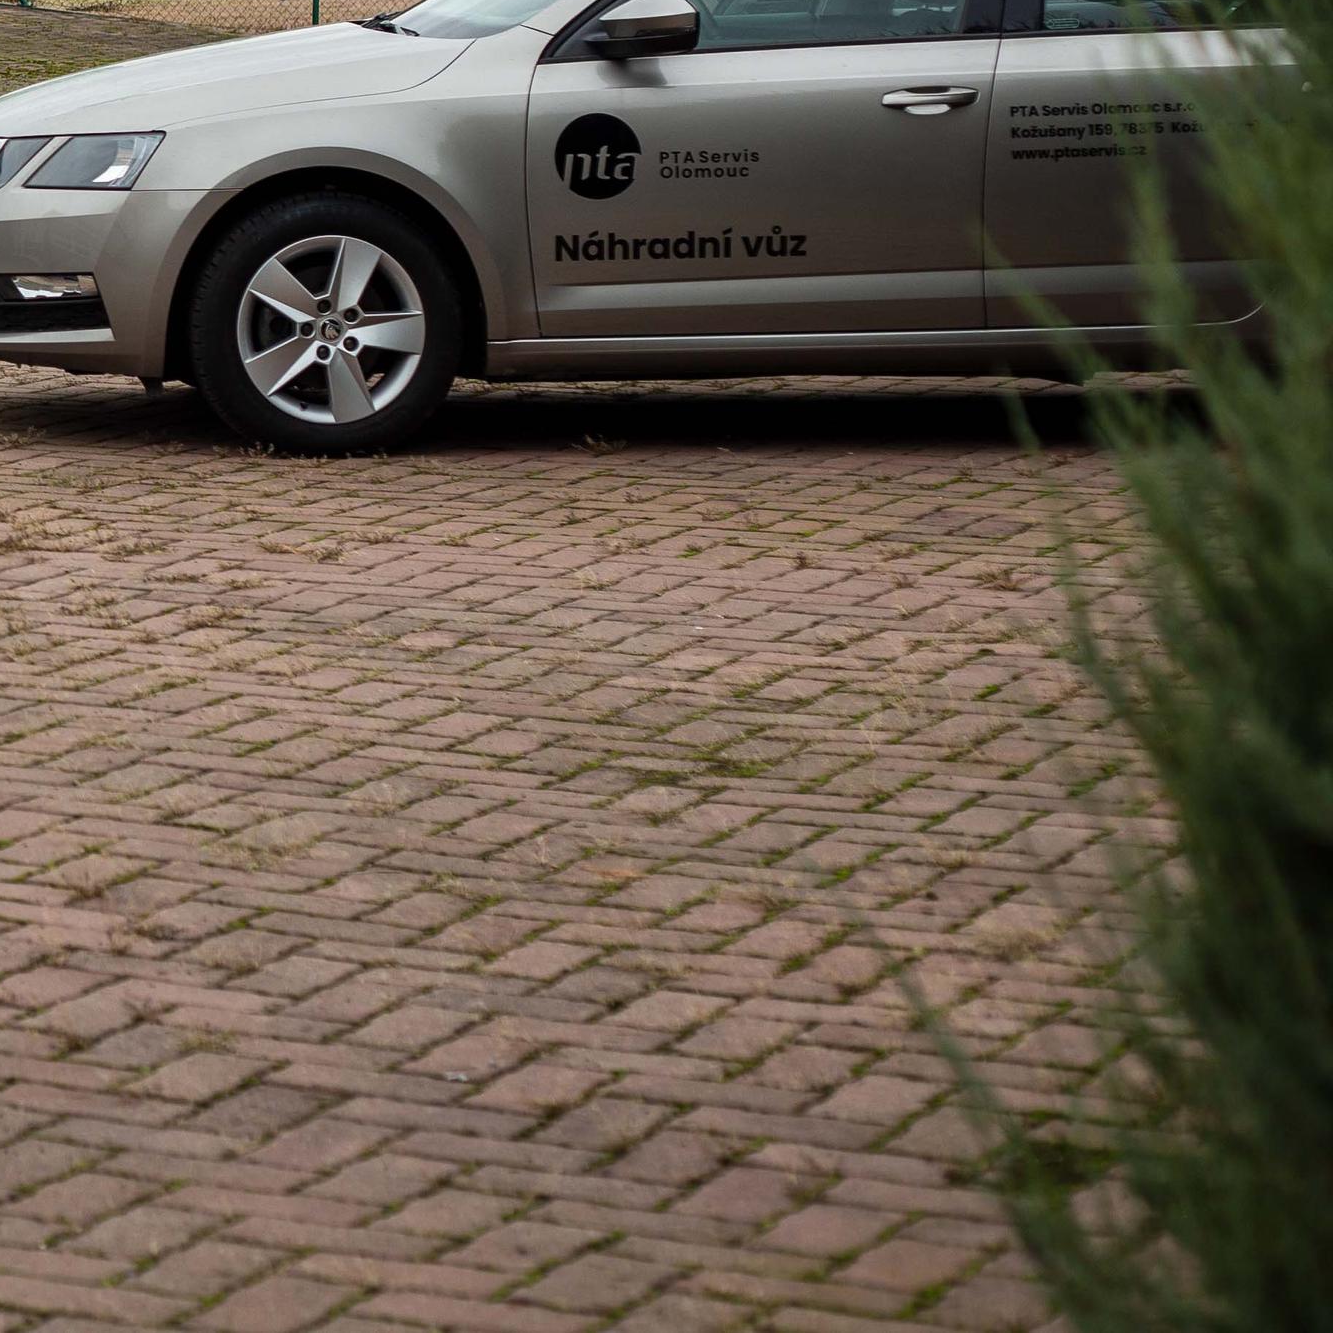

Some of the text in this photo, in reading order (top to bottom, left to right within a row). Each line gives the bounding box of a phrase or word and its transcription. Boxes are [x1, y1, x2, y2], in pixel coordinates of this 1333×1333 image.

[1011, 105, 1039, 117] PTA
[1041, 102, 1088, 117] Servis
[1011, 124, 1085, 140] Kožušany
[659, 148, 760, 164] PTA Servis
[1011, 144, 1147, 162] www.ptaserviscz
[562, 145, 642, 189] pta
[659, 165, 750, 179] Olomouc
[554, 225, 807, 261] Náhradní vůz
